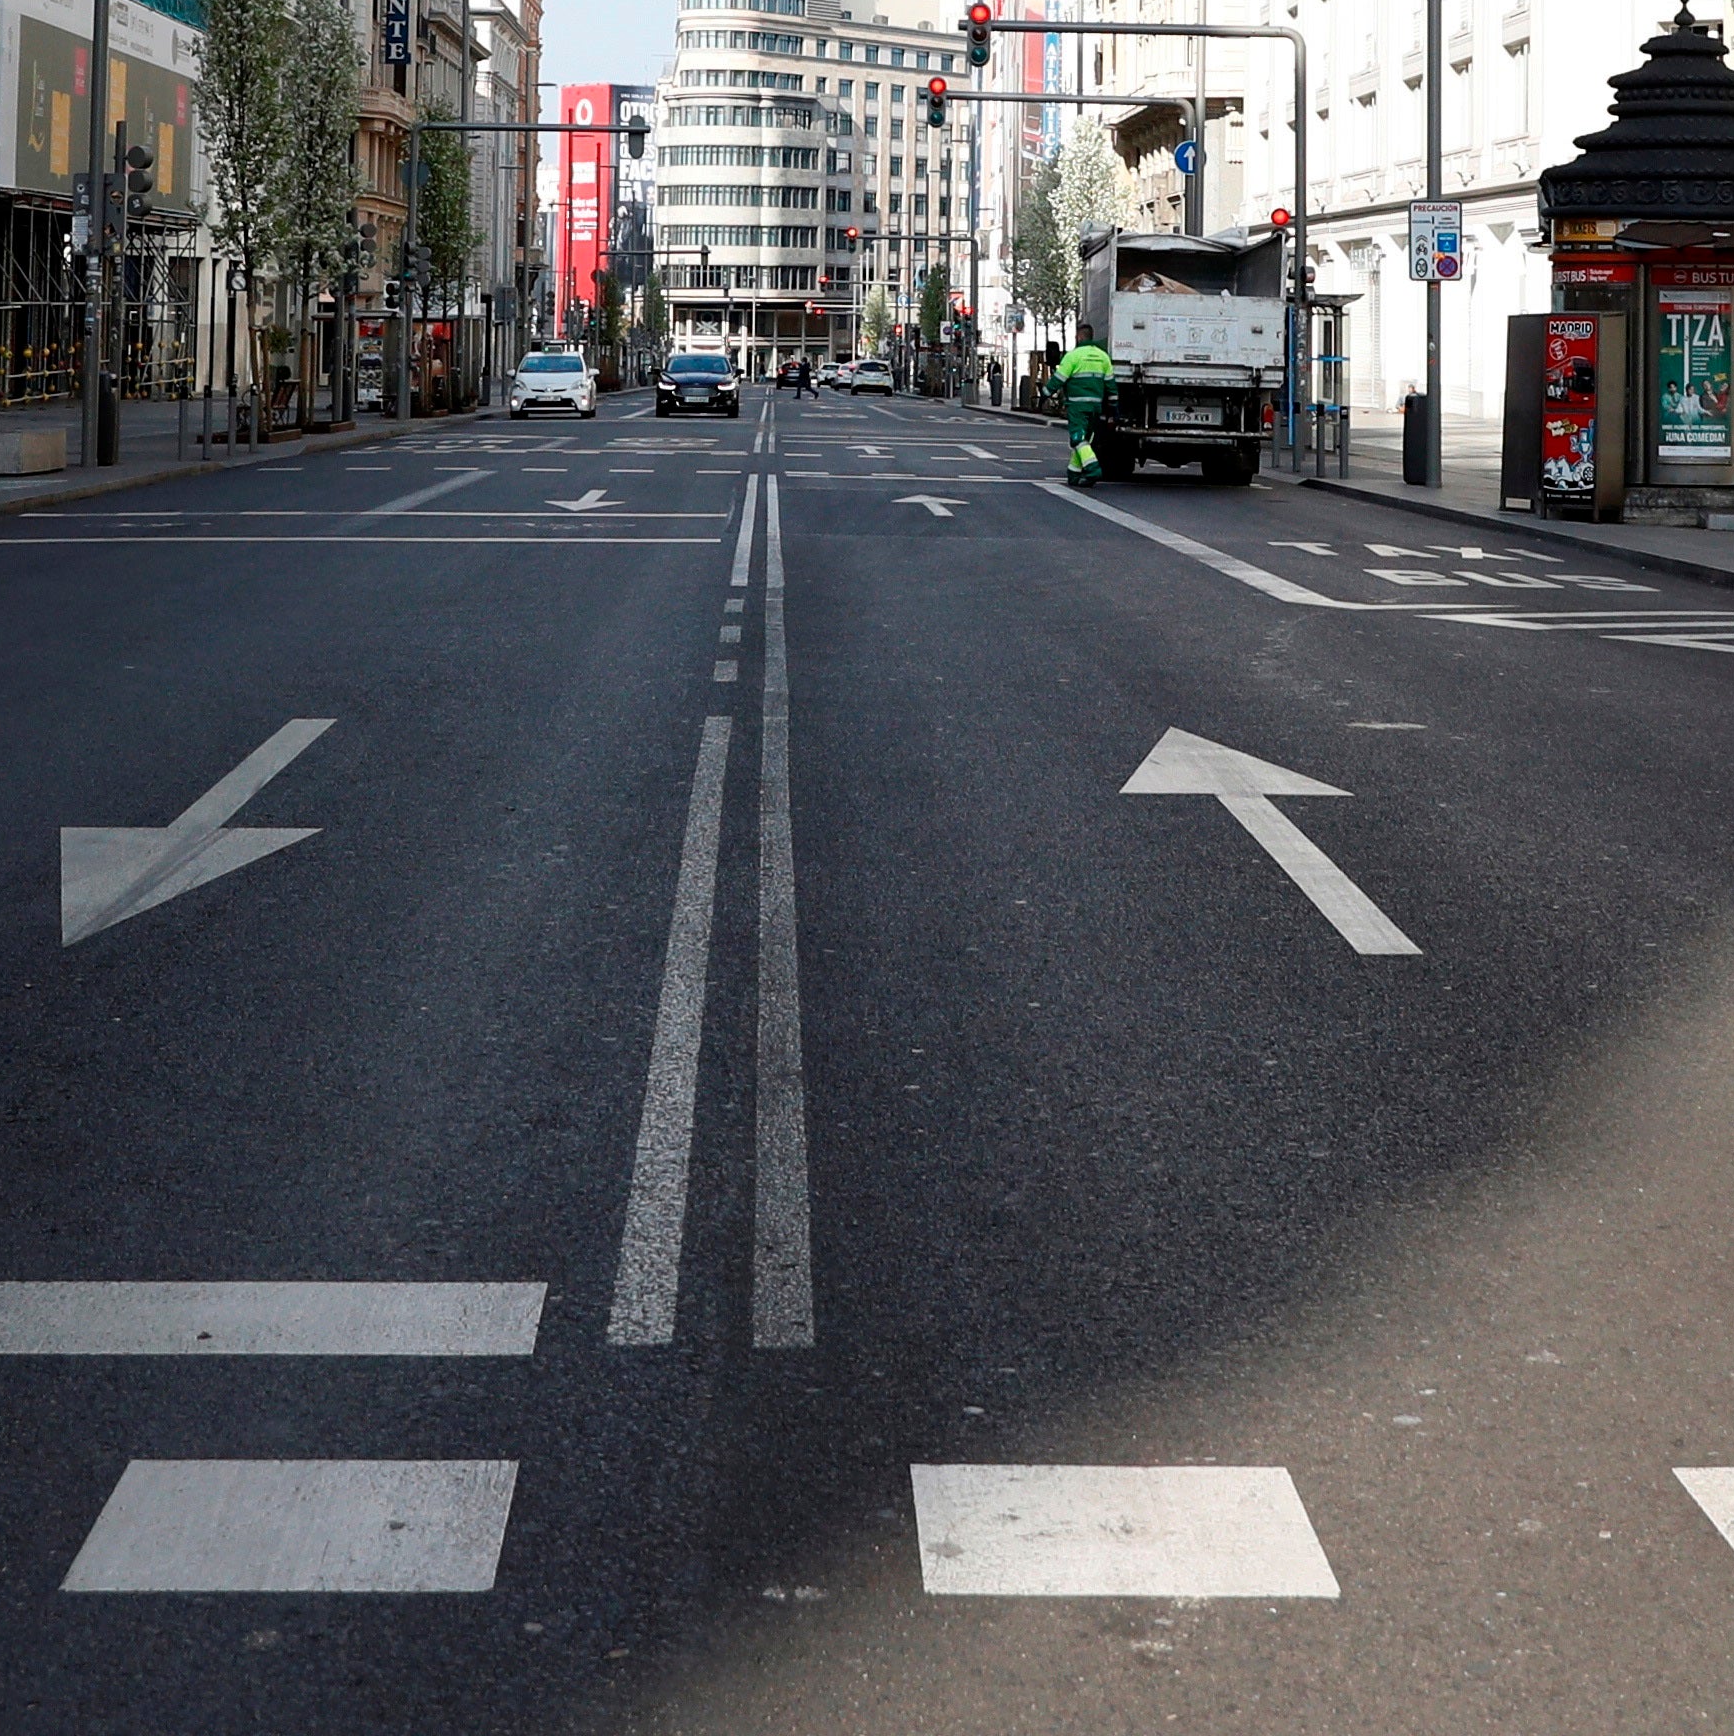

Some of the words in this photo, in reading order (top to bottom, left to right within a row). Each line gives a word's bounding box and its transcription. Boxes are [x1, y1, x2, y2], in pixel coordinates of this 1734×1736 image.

[1413, 204, 1459, 213] PRECAUCIÓN
[1570, 269, 1587, 282] BUS
[1691, 272, 1717, 284] BUS
[1549, 321, 1594, 335] MADRID
[1666, 314, 1725, 347] TIZA
[1686, 431, 1726, 443] COMEDIA!
[1363, 568, 1661, 592] BUS
